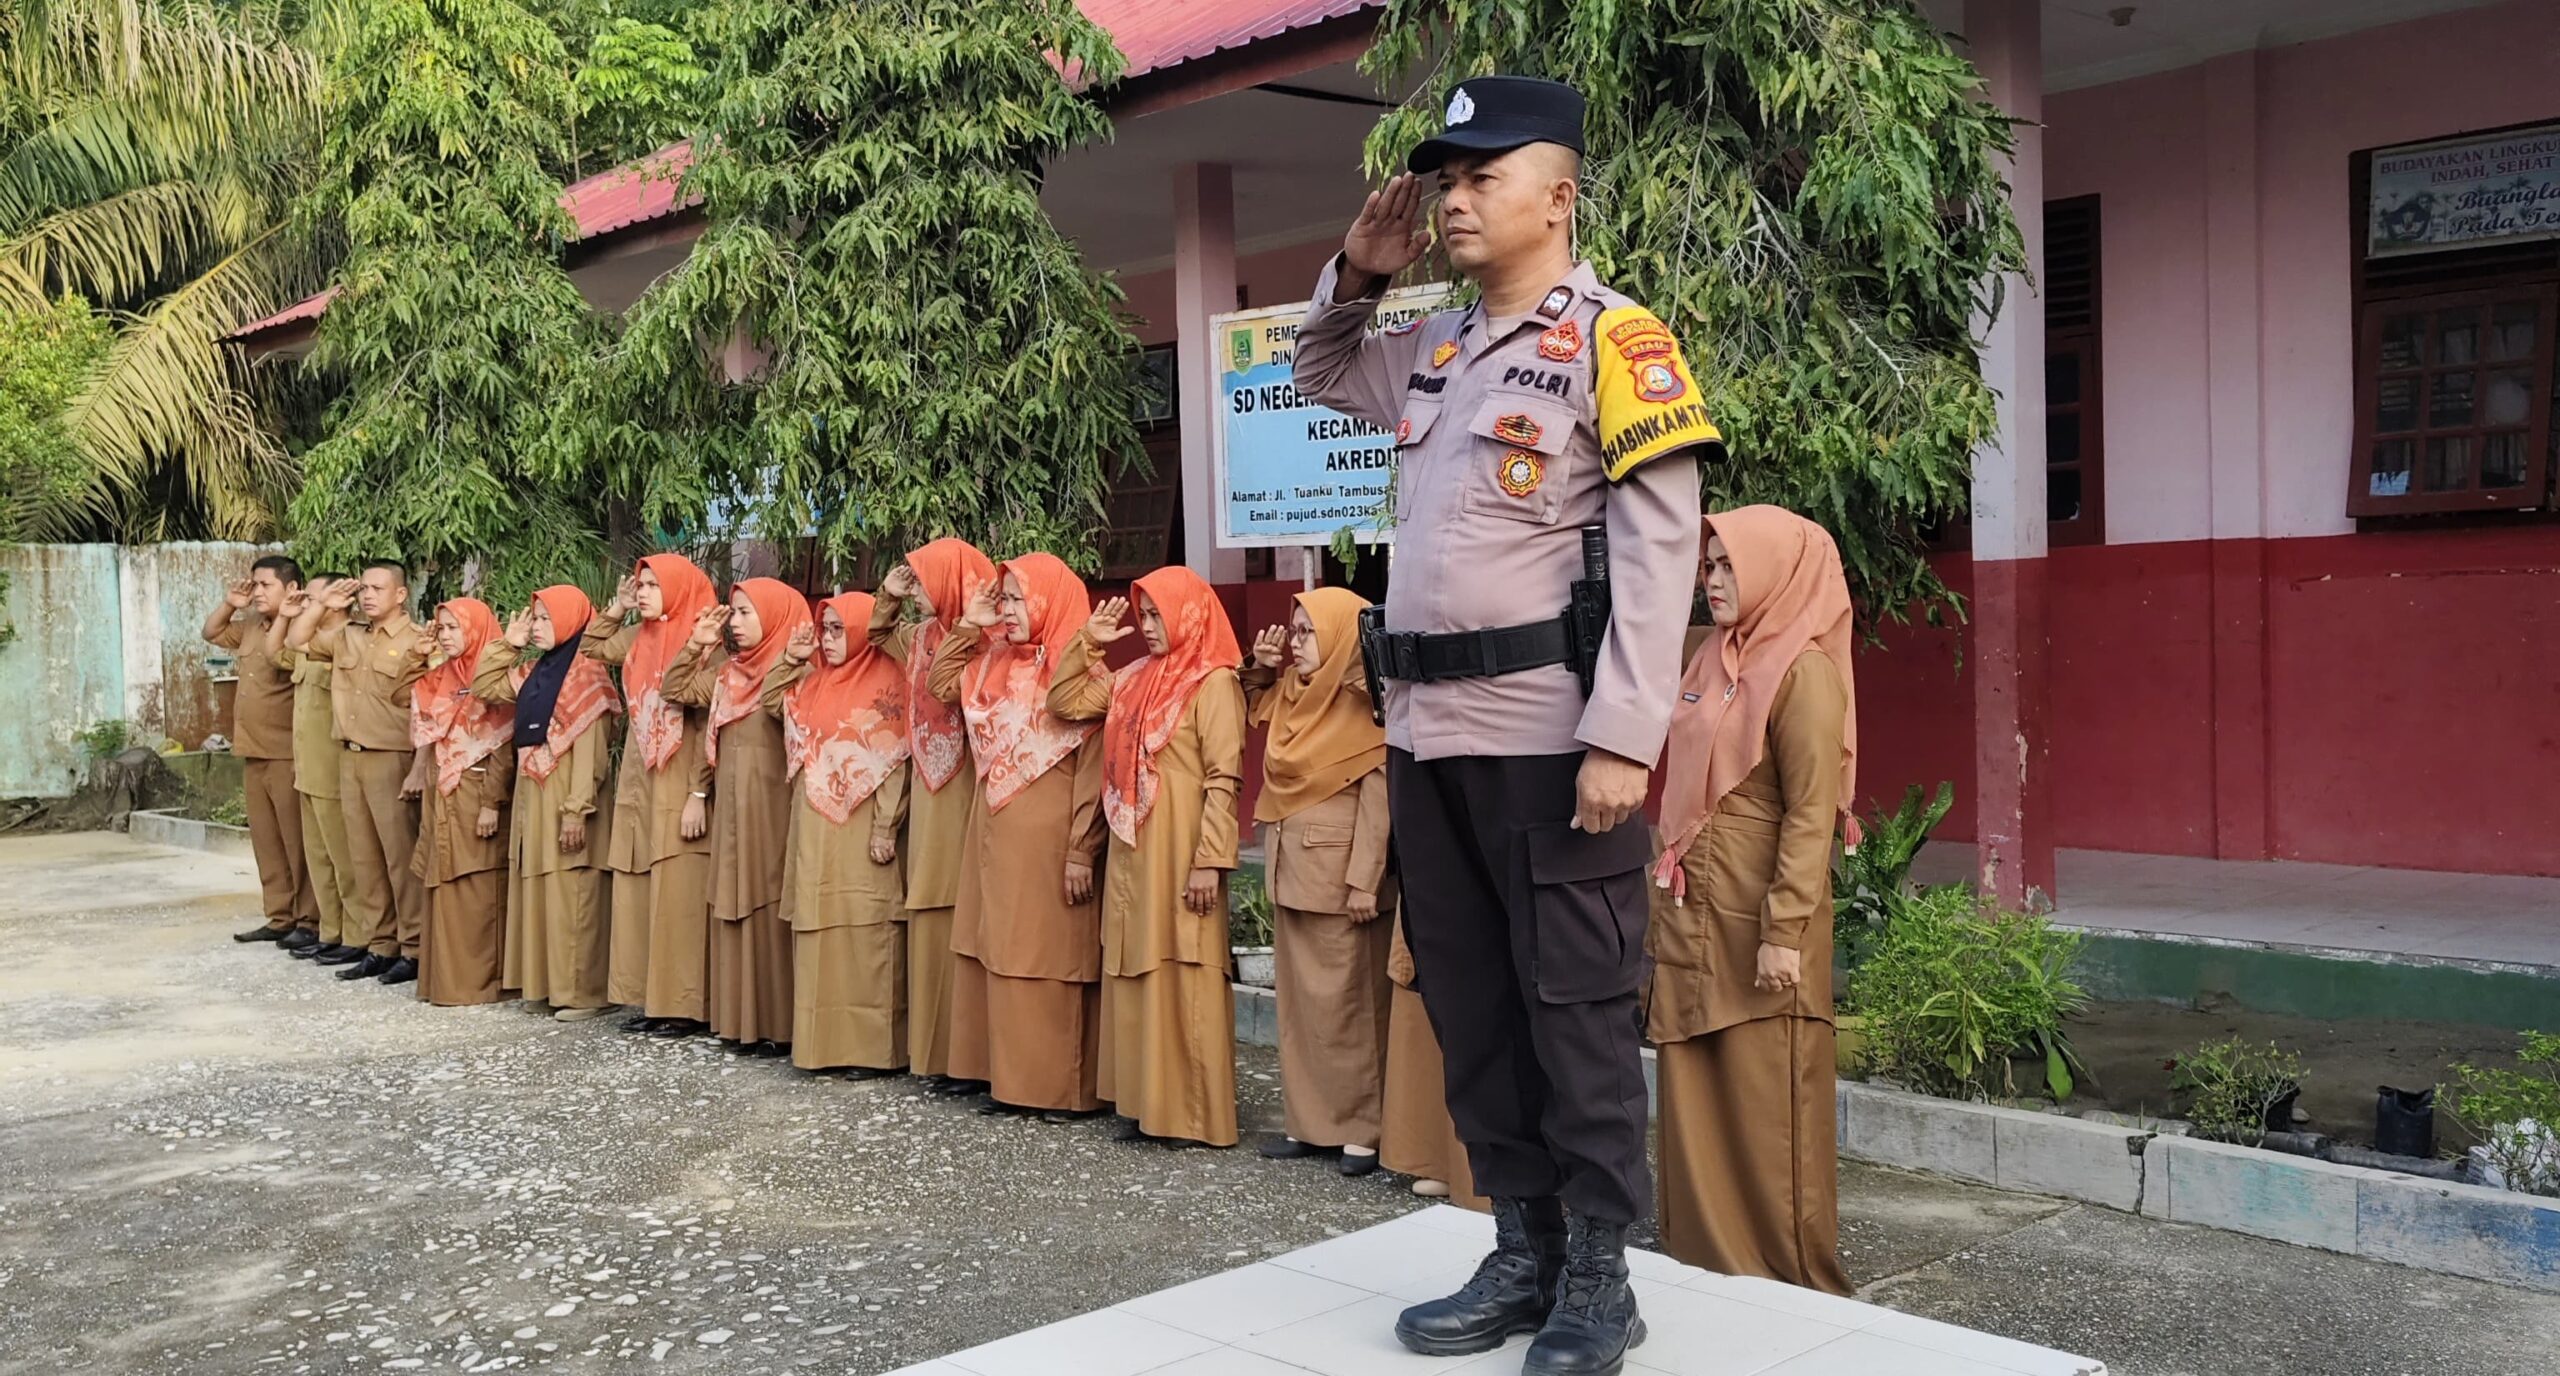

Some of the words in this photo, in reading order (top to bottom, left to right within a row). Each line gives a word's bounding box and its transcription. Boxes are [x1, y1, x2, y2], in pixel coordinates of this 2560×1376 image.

[2380, 150, 2484, 175] BUDAYAKAN
[2490, 140, 2560, 159] LINGKU
[2431, 165, 2490, 184] INDAH,
[2496, 156, 2556, 174] SEHAT
[2525, 208, 2560, 227] Te
[1266, 324, 1302, 343] PEME
[1631, 342, 1664, 354] RIAU
[1271, 350, 1293, 366] DIN
[1503, 366, 1572, 398] POLRI
[1233, 388, 1255, 414] SD
[1231, 491, 1267, 502] Alamat
[1294, 486, 1333, 498] Tuanku
[1250, 508, 1278, 522] Email
